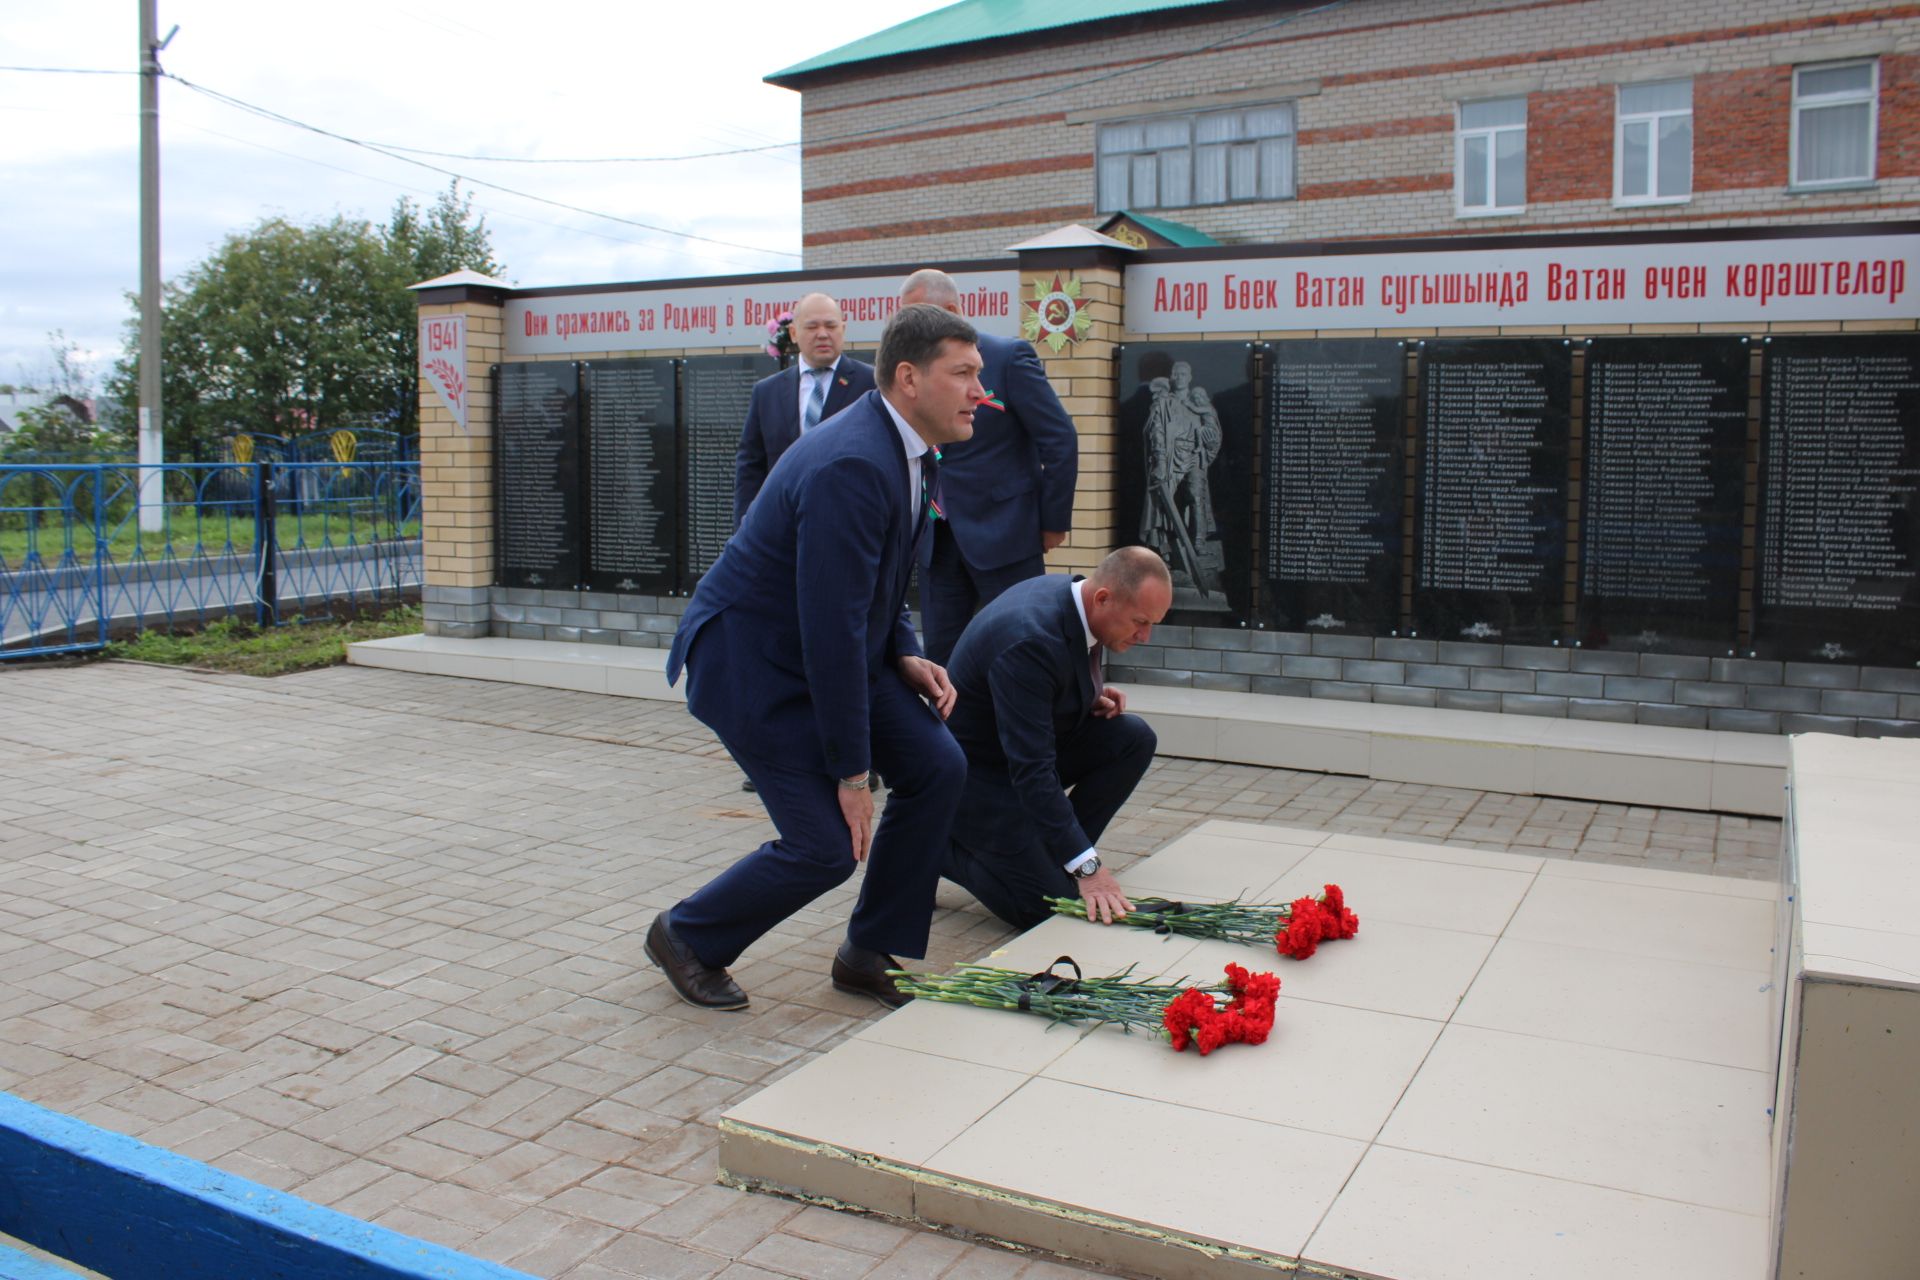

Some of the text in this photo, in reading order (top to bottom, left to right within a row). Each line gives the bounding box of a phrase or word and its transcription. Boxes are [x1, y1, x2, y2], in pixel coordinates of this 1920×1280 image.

[1153, 259, 1906, 319] Алар Бөек Ватан сугышында Ватан өчен көрәштеләр
[427, 322, 458, 352] 1941
[524, 310, 549, 337] Они
[556, 311, 631, 341] сражались
[638, 309, 656, 332] за
[663, 302, 717, 334] Родину
[726, 304, 735, 327] в
